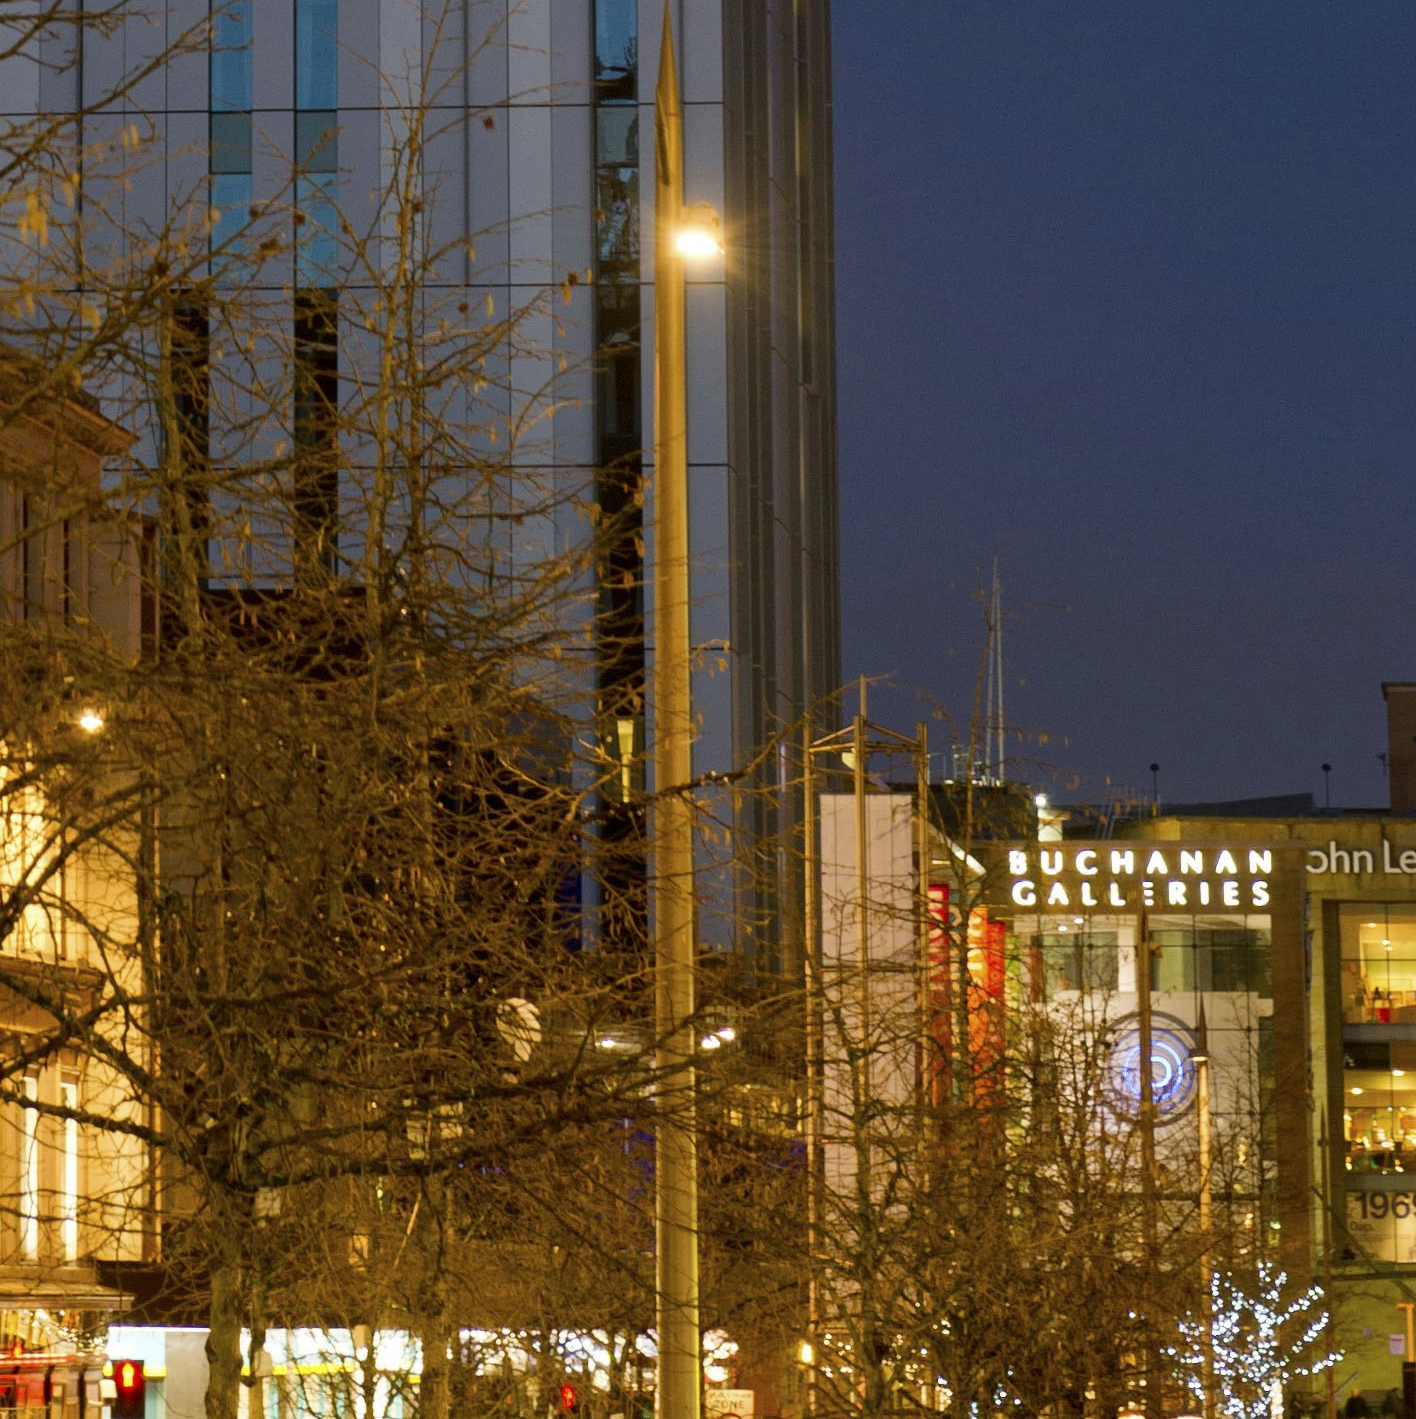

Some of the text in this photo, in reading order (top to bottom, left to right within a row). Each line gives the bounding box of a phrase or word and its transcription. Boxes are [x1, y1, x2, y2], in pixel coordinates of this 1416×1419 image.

[1009, 849, 1273, 875] BUCHANAN
[1011, 880, 1271, 906] GALLERIES
[1355, 1192, 1416, 1219] 196
